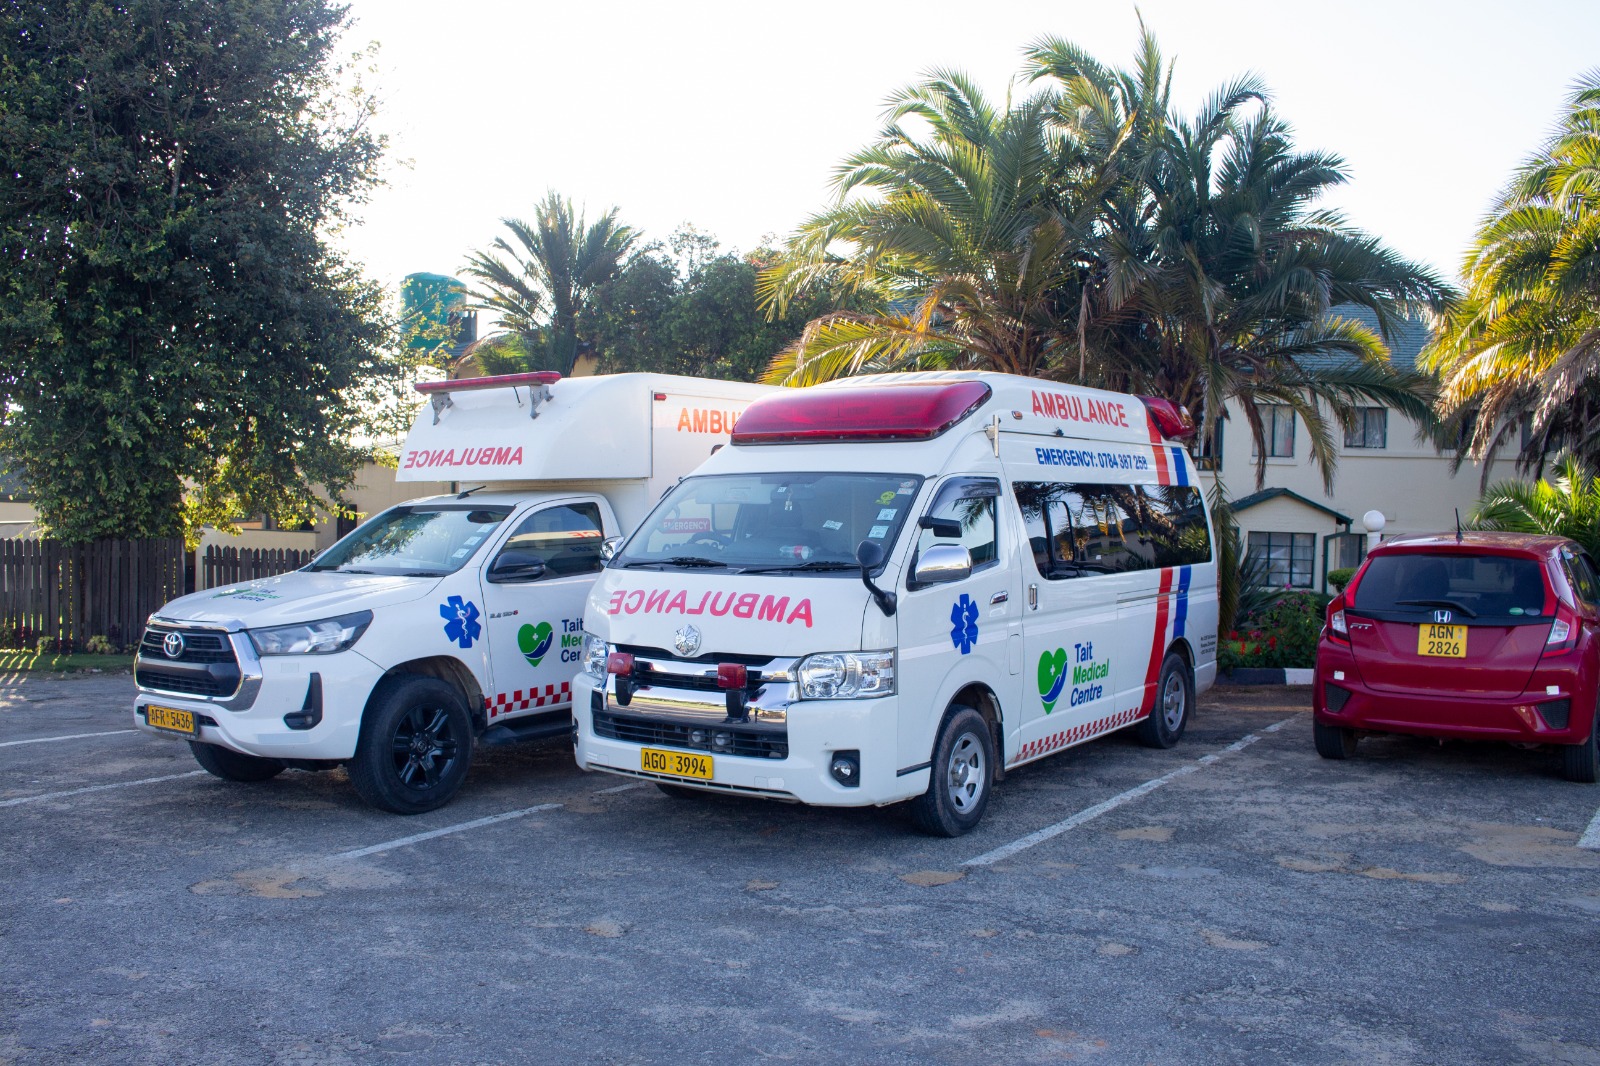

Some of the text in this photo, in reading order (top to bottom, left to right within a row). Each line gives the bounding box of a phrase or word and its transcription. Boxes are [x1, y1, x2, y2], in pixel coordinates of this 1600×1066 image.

[1031, 389, 1129, 428] AMBULANCE
[677, 407, 741, 435] AMBU
[1035, 447, 1098, 468] EMERGENCY:
[561, 617, 584, 632] Tait
[1428, 625, 1454, 640] AGN
[1074, 641, 1093, 663] Tait
[1428, 641, 1460, 655] 2826
[1072, 658, 1110, 686] Medical
[1070, 683, 1103, 707] Centre
[151, 708, 191, 729] AFR 5436
[644, 751, 707, 776] AGO 3994
